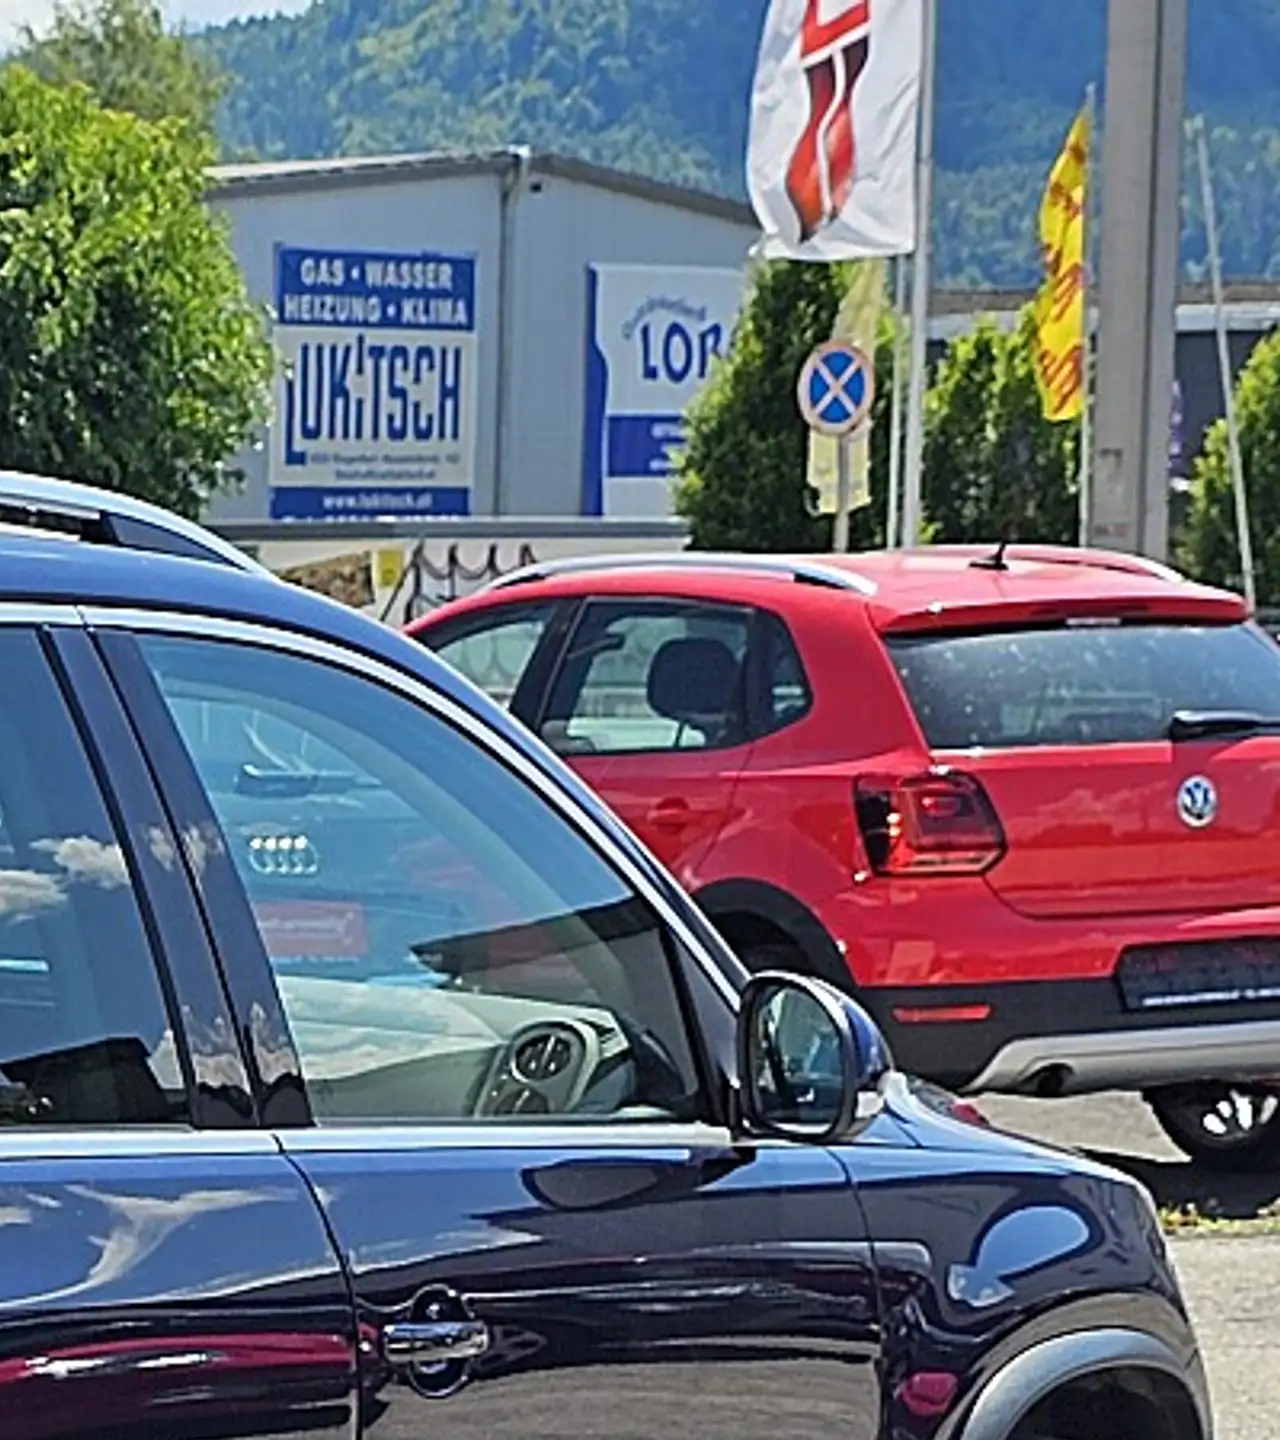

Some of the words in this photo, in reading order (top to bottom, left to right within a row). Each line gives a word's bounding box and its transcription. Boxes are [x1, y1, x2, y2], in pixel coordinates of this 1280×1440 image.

[300, 258, 345, 287] GAS
[364, 260, 454, 290] WASSER
[284, 294, 382, 323] HEIZUNG
[401, 298, 468, 325] KLIMA
